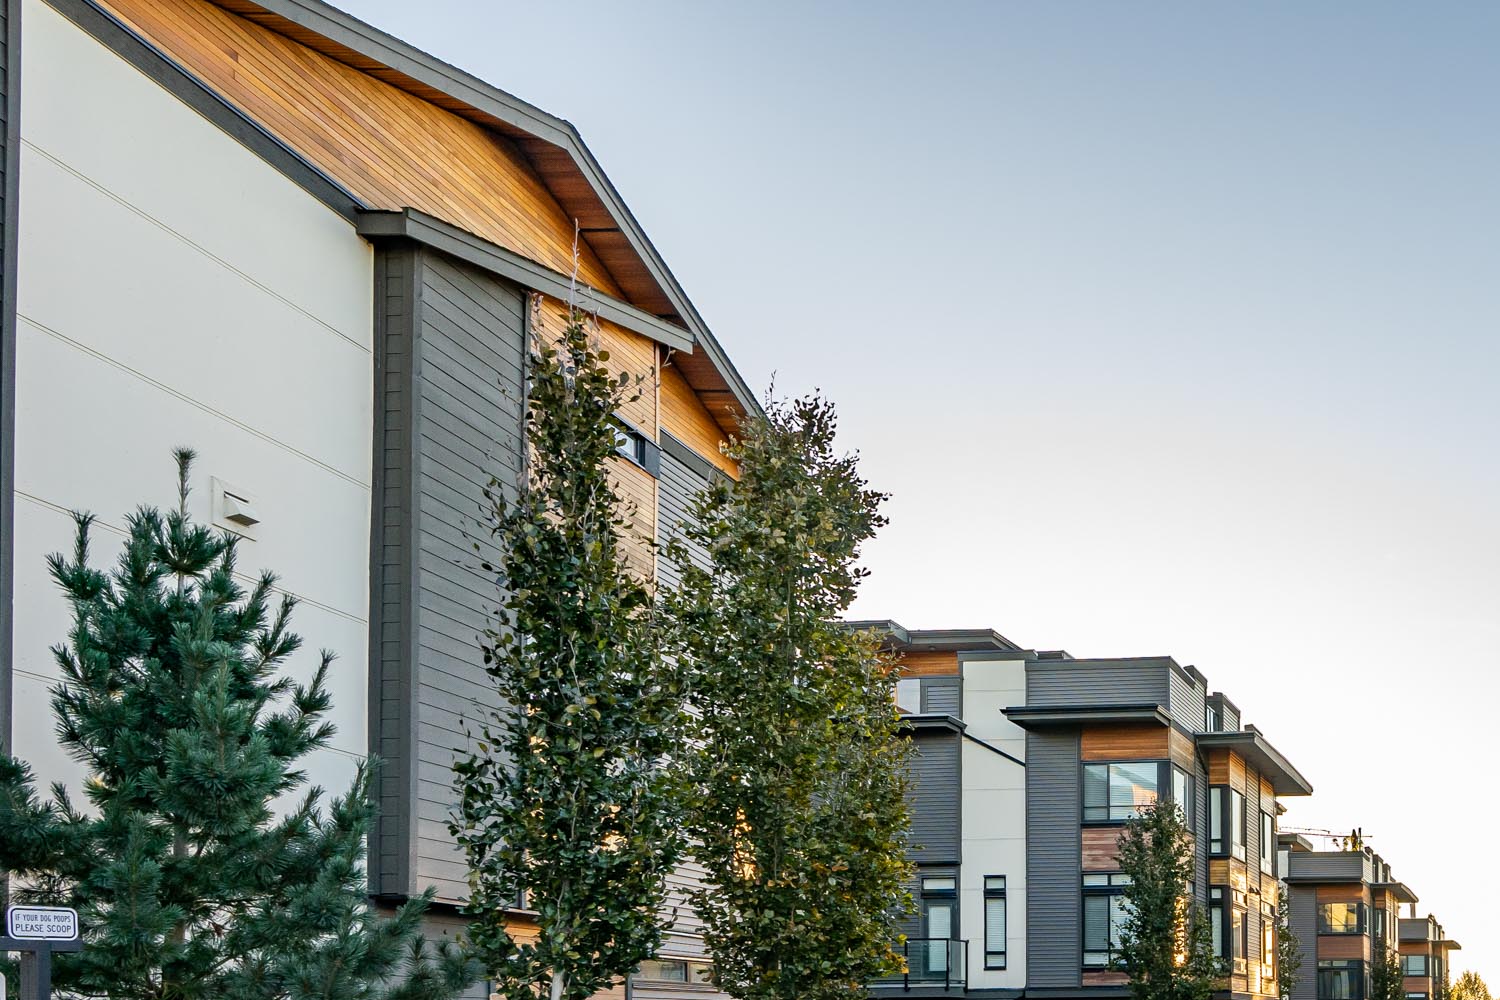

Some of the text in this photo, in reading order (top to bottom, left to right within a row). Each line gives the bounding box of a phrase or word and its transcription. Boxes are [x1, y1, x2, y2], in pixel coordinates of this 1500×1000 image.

[53, 915, 71, 923] POOPS
[15, 924, 72, 933] PLEASE SCOOP
